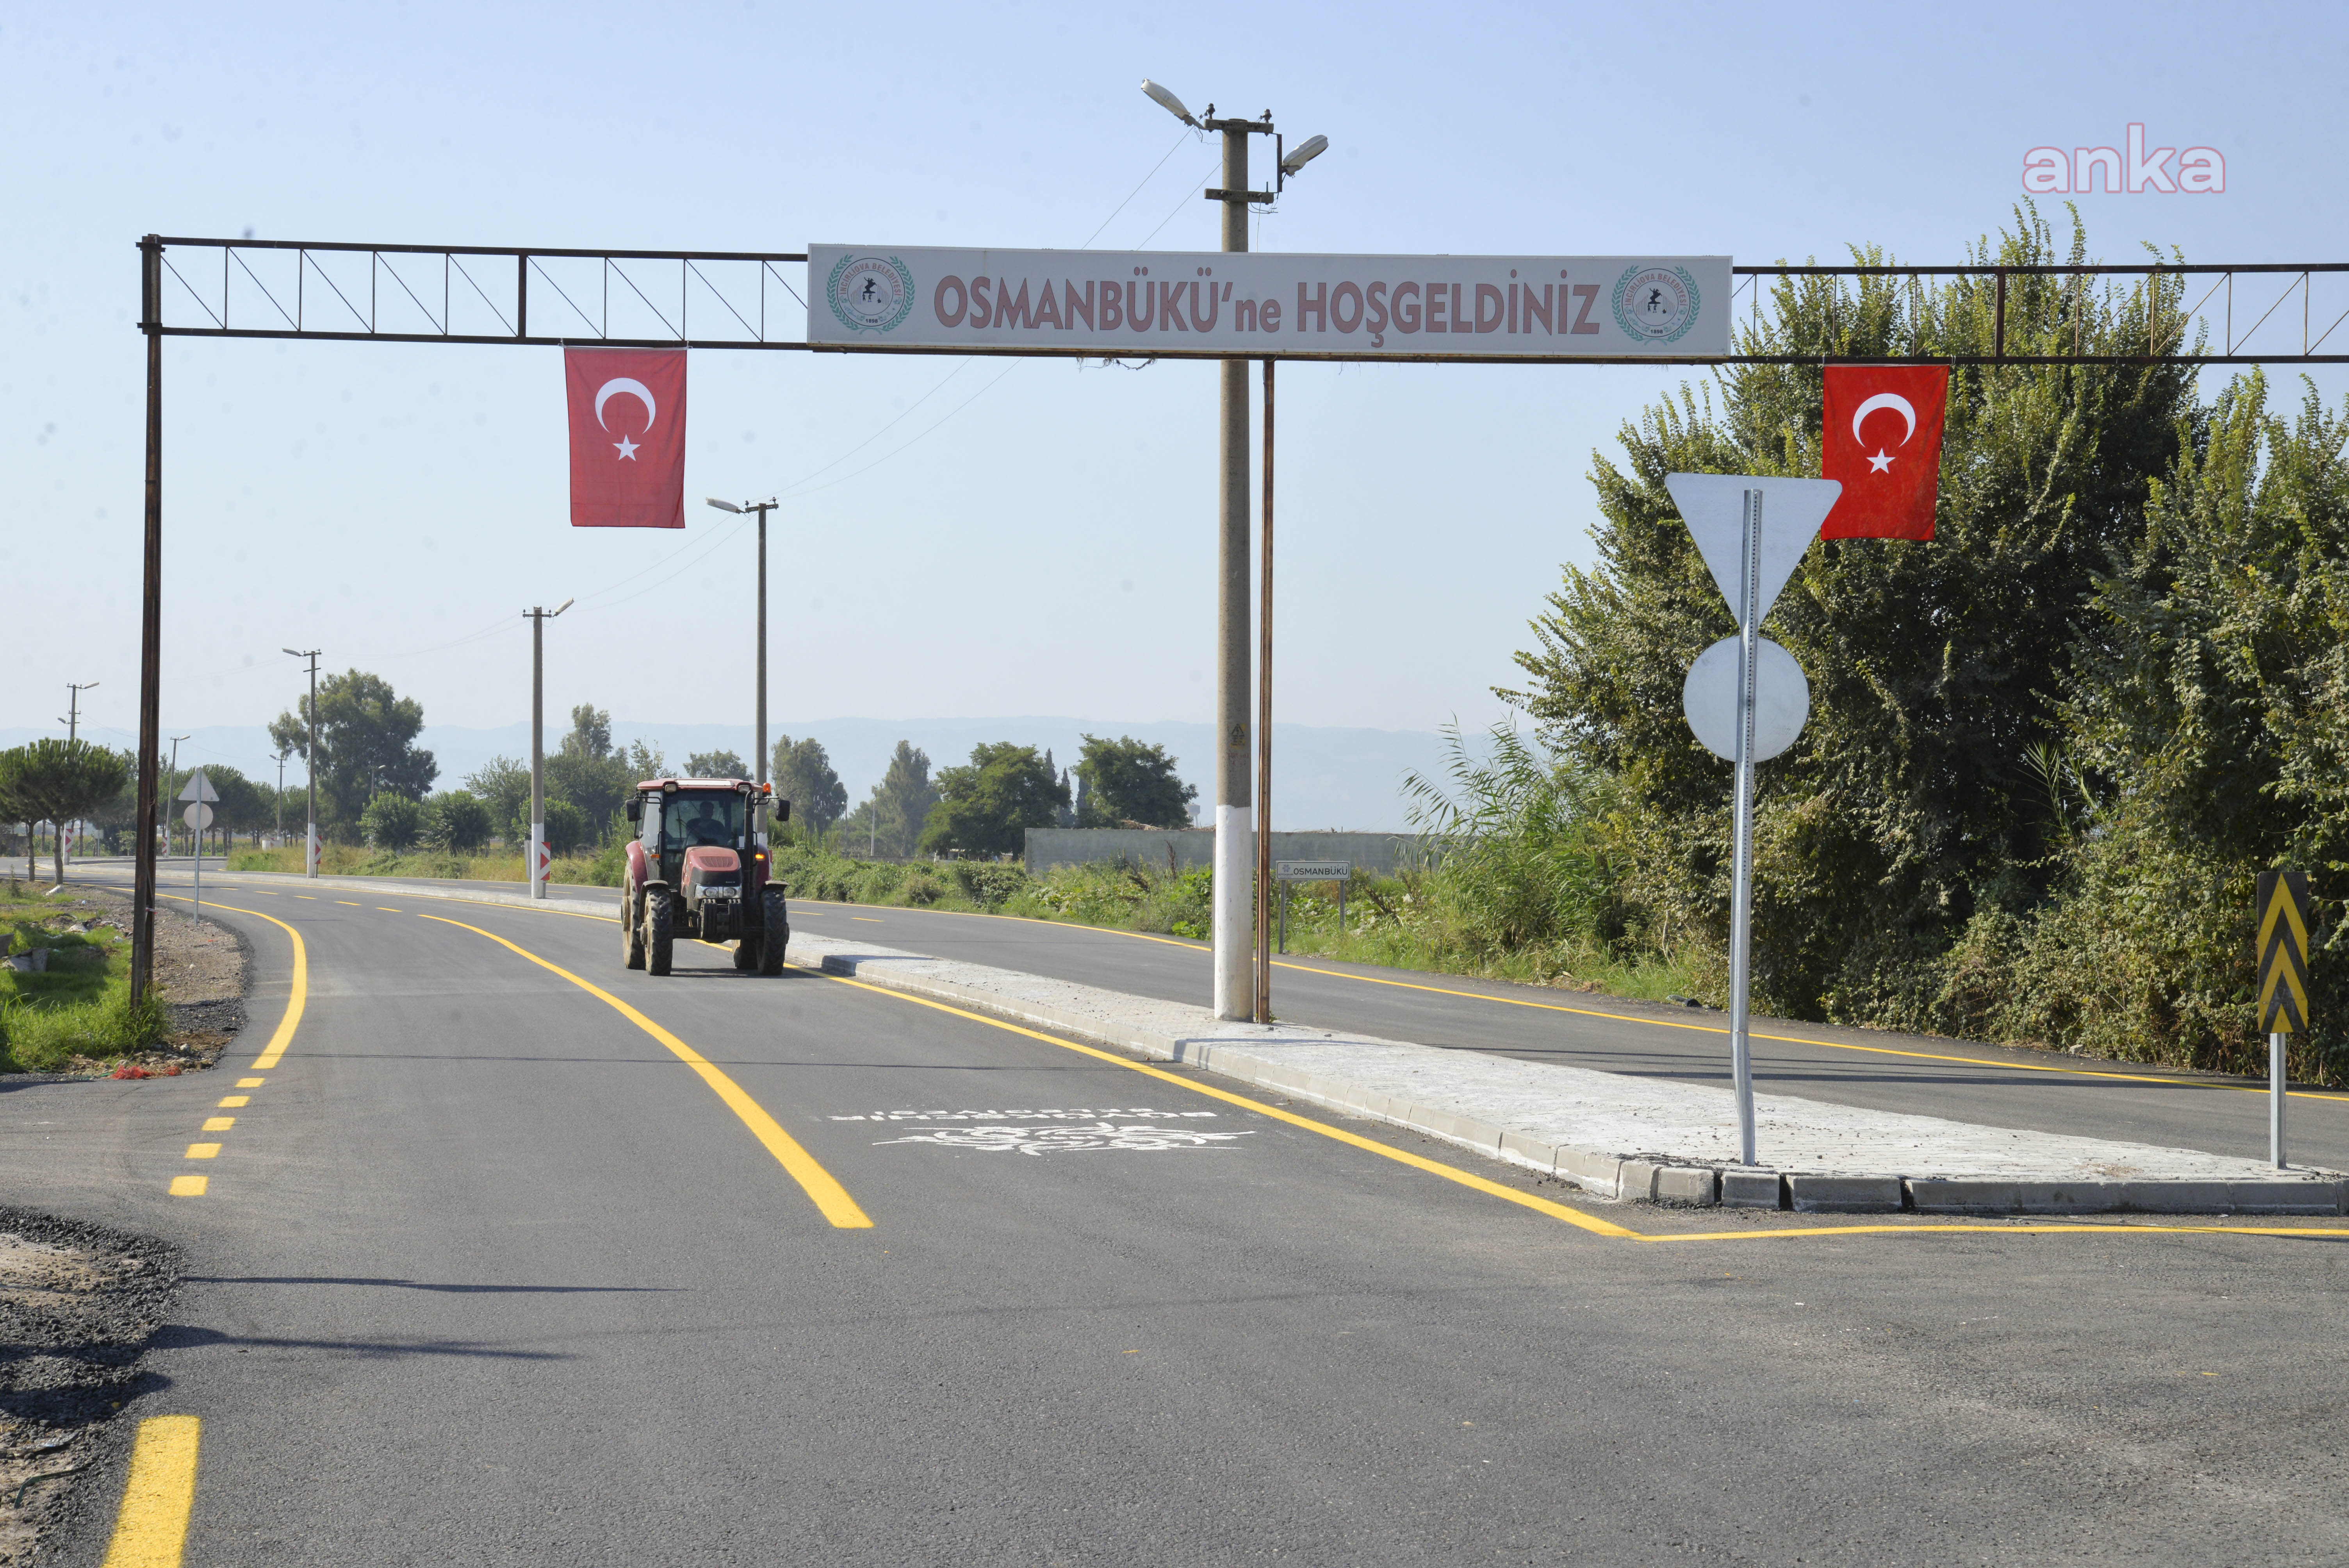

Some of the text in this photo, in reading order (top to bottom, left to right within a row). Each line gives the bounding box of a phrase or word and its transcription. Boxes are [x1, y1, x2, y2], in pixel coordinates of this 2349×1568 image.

[839, 263, 903, 296] İNCİRLİOVA BELEDİYESİ
[1624, 273, 1688, 306] İNCİRLİOVA BELEDİYESİ
[934, 267, 1601, 348] OSMANBÜKÜ'ne HOŞGELDİNİZ
[1293, 866, 1347, 875] OSMANBÜKÜ
